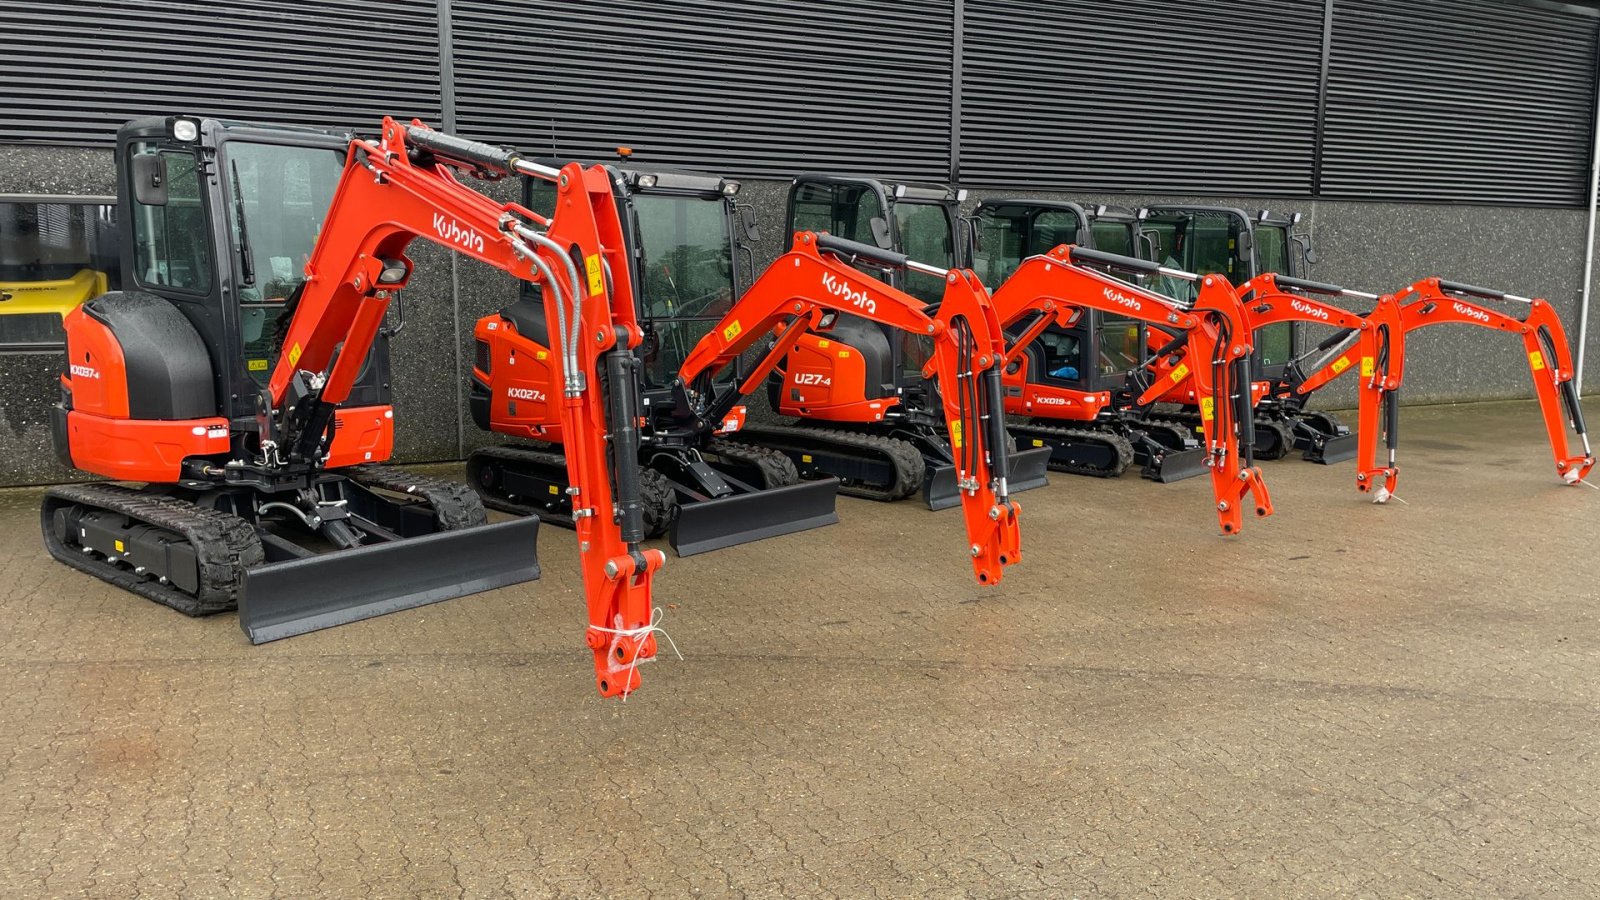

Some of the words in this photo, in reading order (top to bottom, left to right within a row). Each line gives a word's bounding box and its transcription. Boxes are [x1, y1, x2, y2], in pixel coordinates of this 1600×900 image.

[433, 212, 484, 253] Kubota
[822, 271, 876, 314] Kubota
[1103, 287, 1141, 311] Kubota
[1291, 299, 1329, 320] Kubota
[1453, 302, 1489, 322] Kubota
[795, 373, 831, 385] U27-4
[508, 387, 546, 401] KX027-4
[1036, 396, 1071, 405] KX019-4
